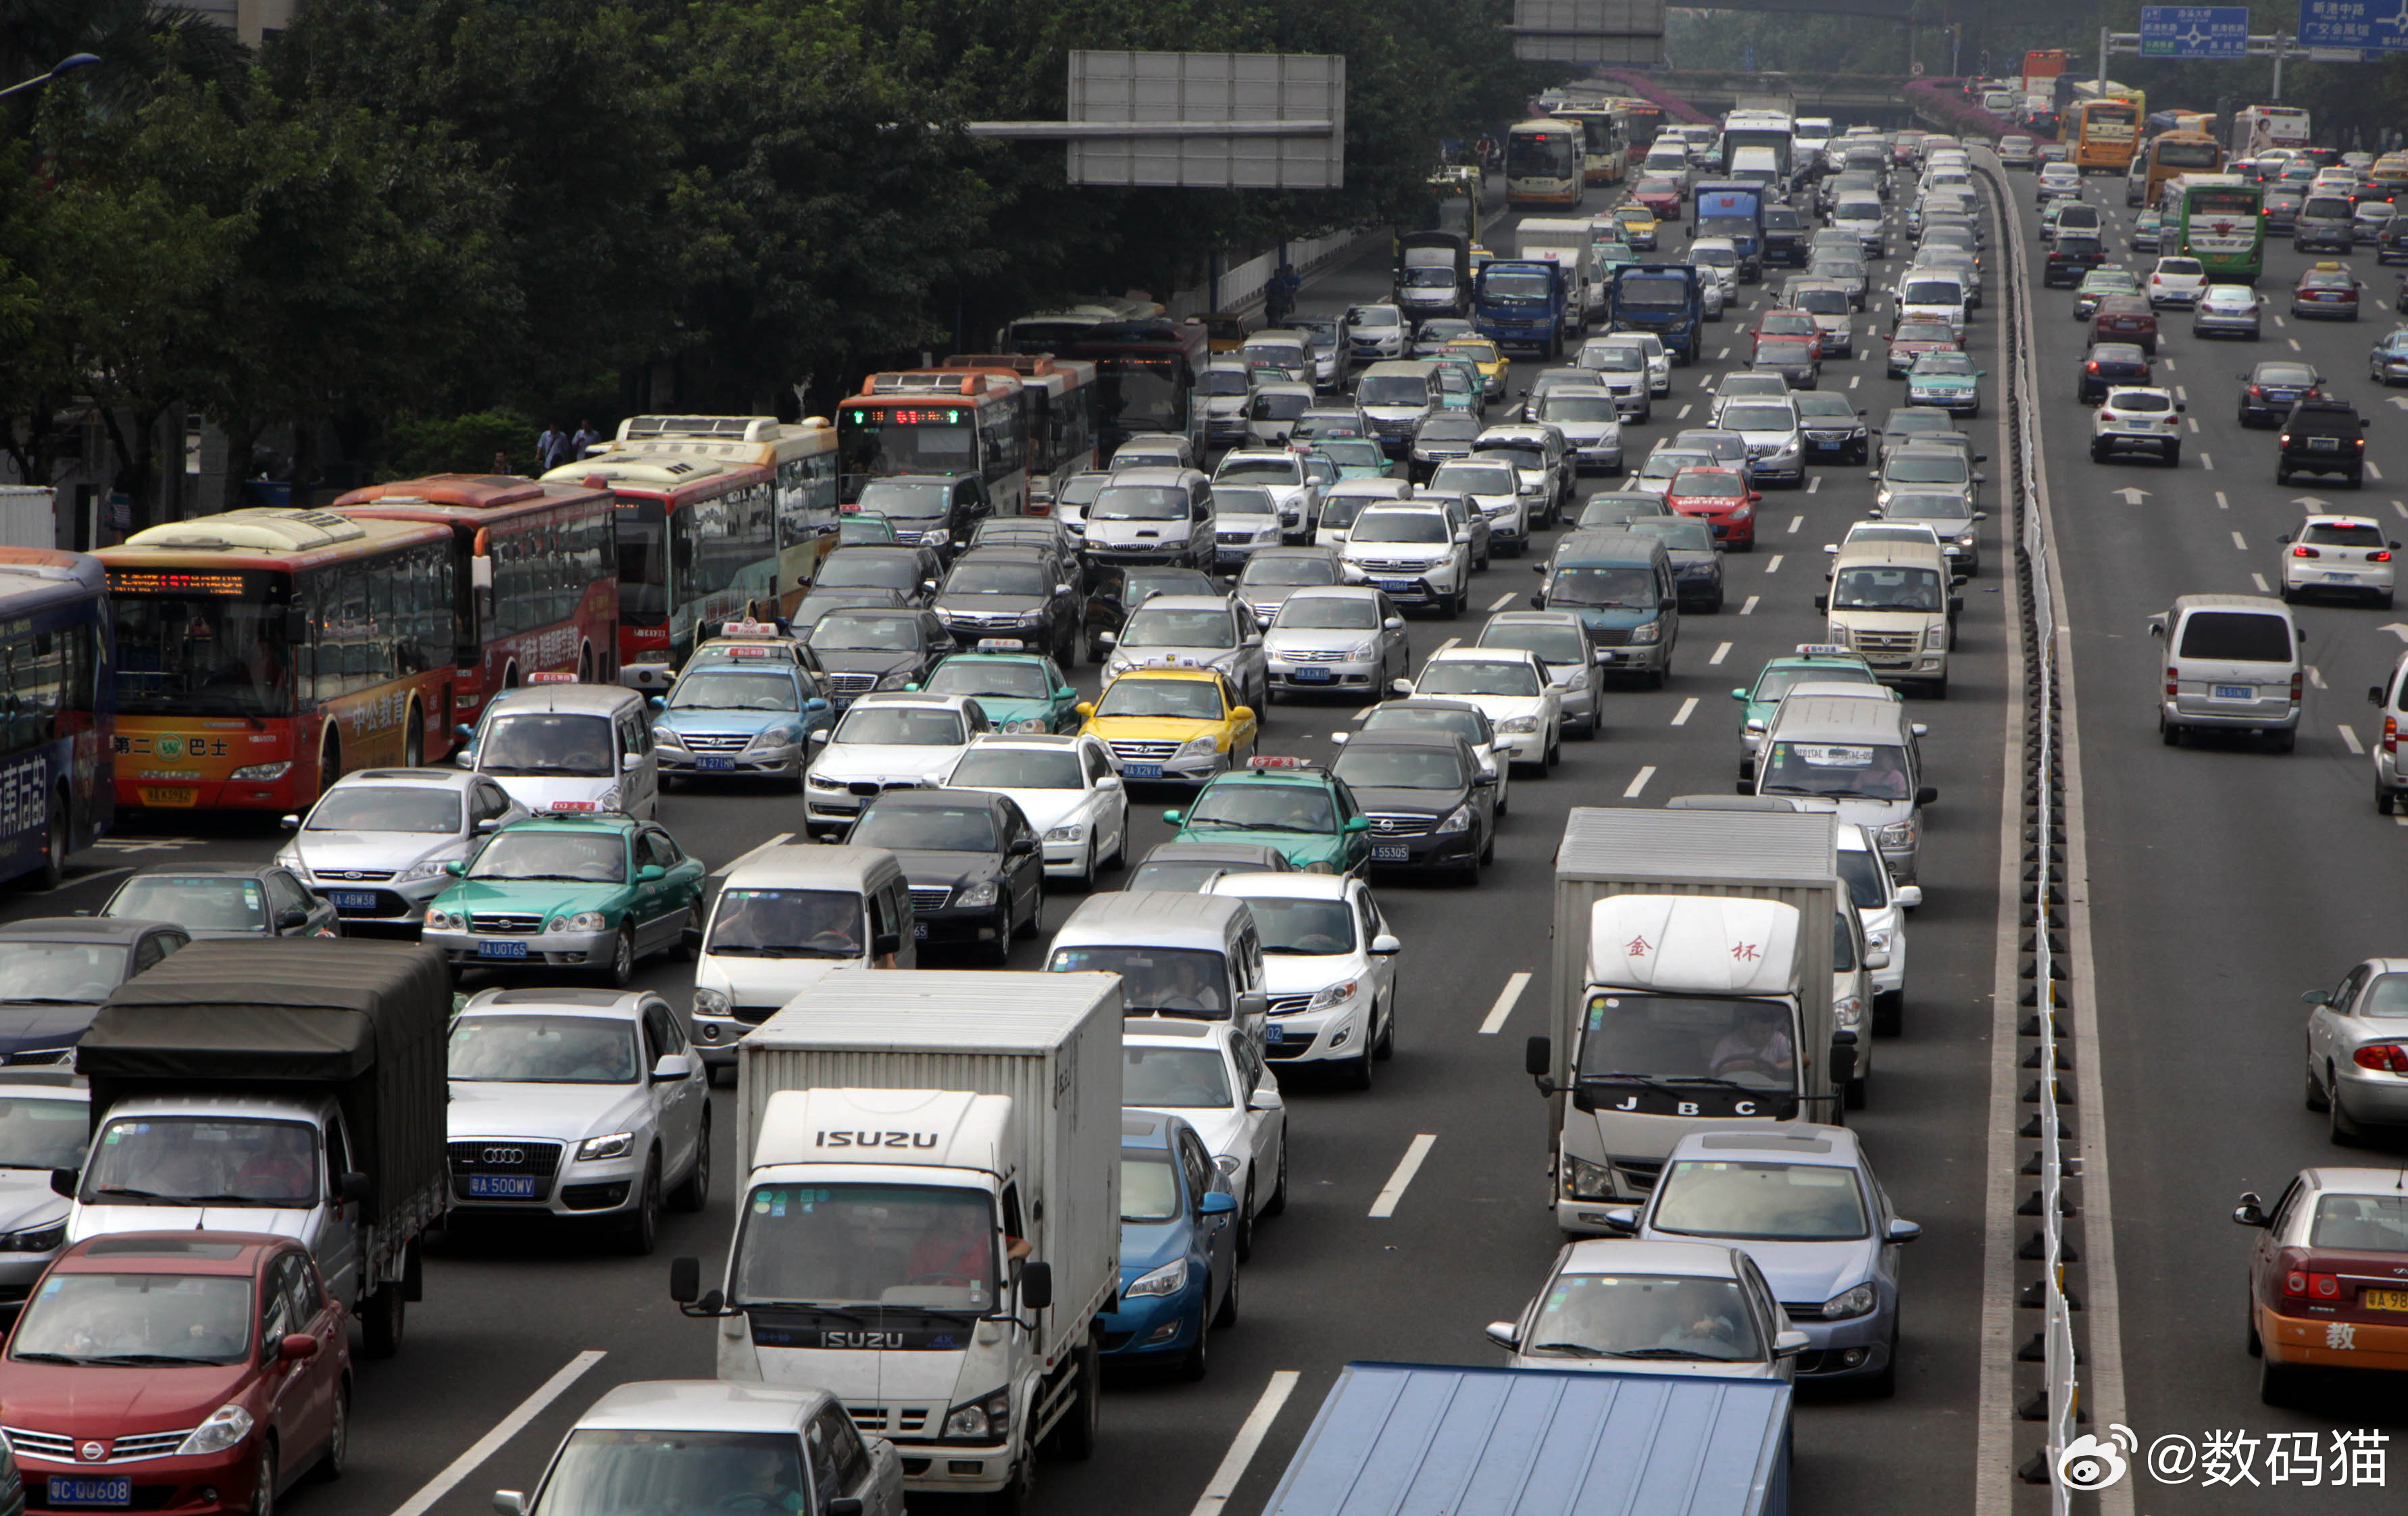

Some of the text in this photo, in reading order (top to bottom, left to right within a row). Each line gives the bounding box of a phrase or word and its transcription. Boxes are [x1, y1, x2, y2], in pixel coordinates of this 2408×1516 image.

[353, 689, 406, 739] 中公教育
[116, 736, 152, 755] 第二
[189, 738, 228, 756] 巴士
[913, 925, 926, 937] 65
[1267, 1027, 1282, 1040] 02
[816, 1131, 938, 1149] ISUZU
[821, 1332, 903, 1348] ISUZU
[2326, 1322, 2357, 1350] 教
